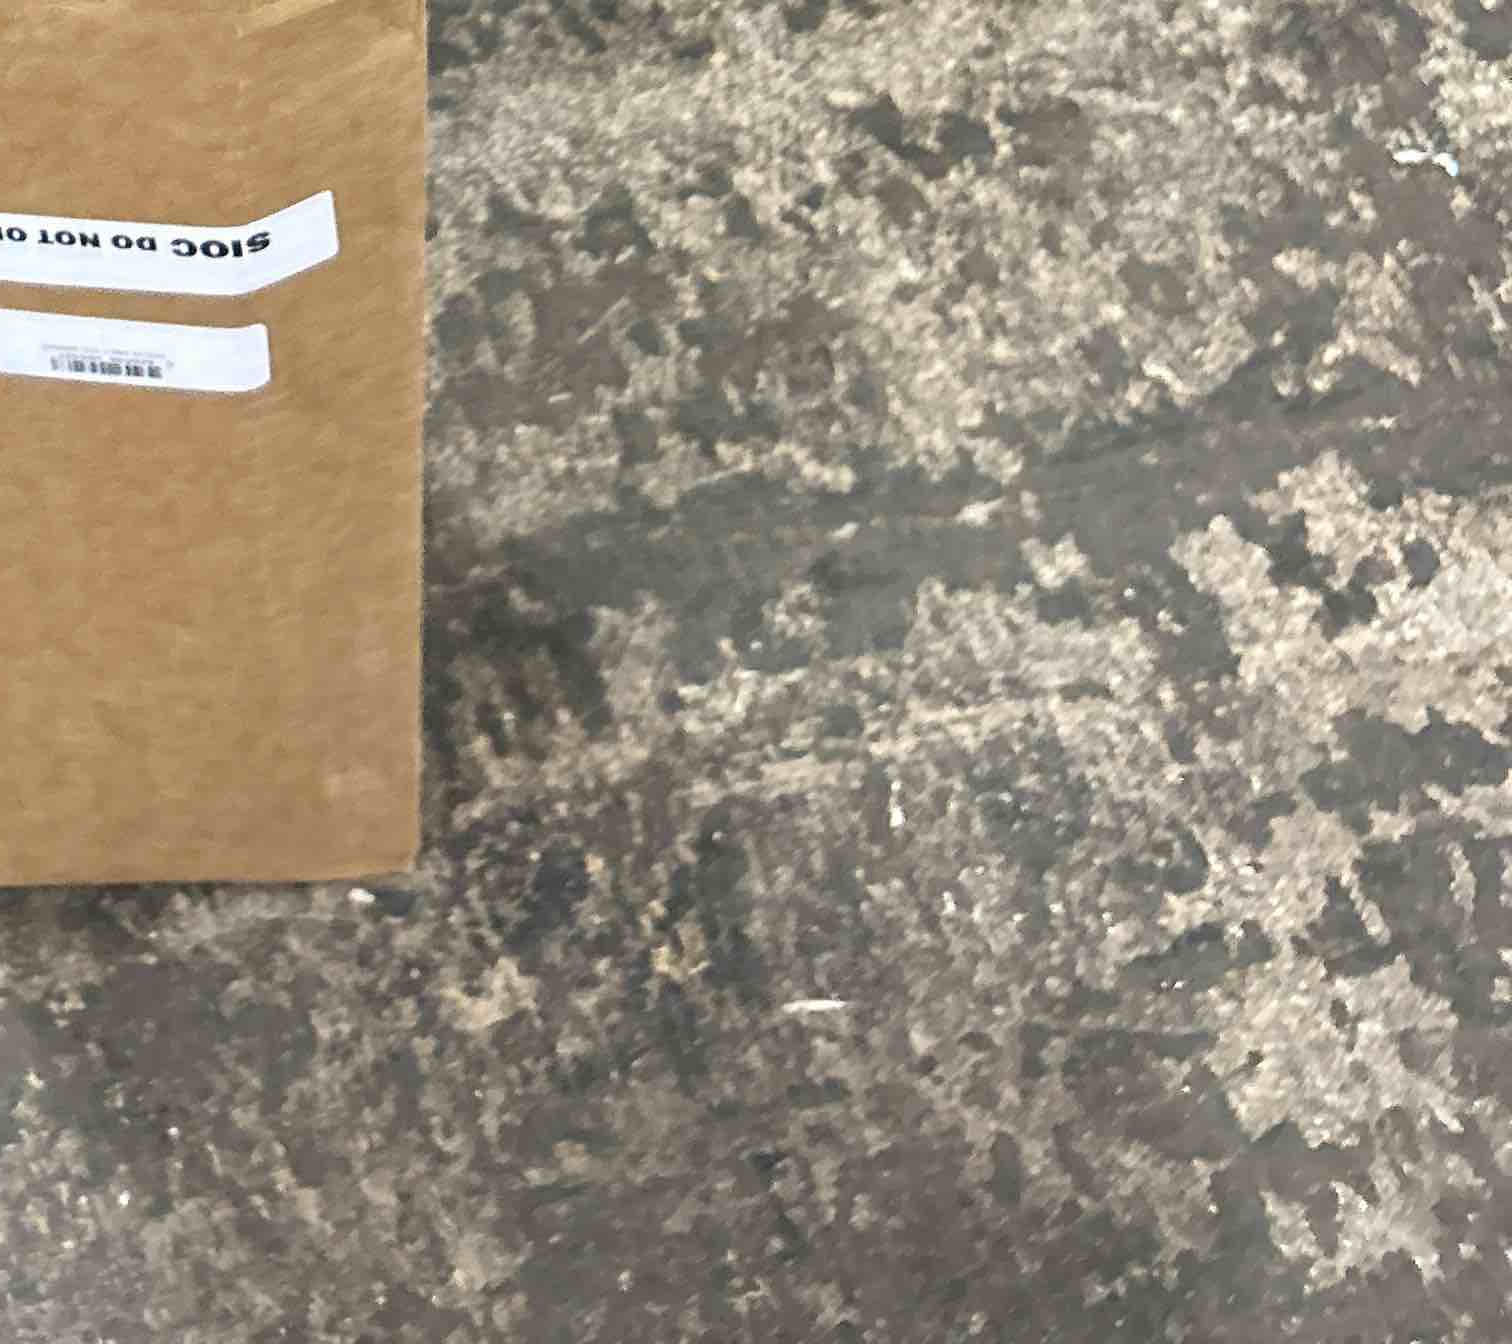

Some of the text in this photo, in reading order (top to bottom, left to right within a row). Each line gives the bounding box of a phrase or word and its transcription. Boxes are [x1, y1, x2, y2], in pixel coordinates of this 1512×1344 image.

[38, 229, 101, 249] NOT
[112, 233, 157, 252] DO
[170, 230, 272, 259] SIOC
